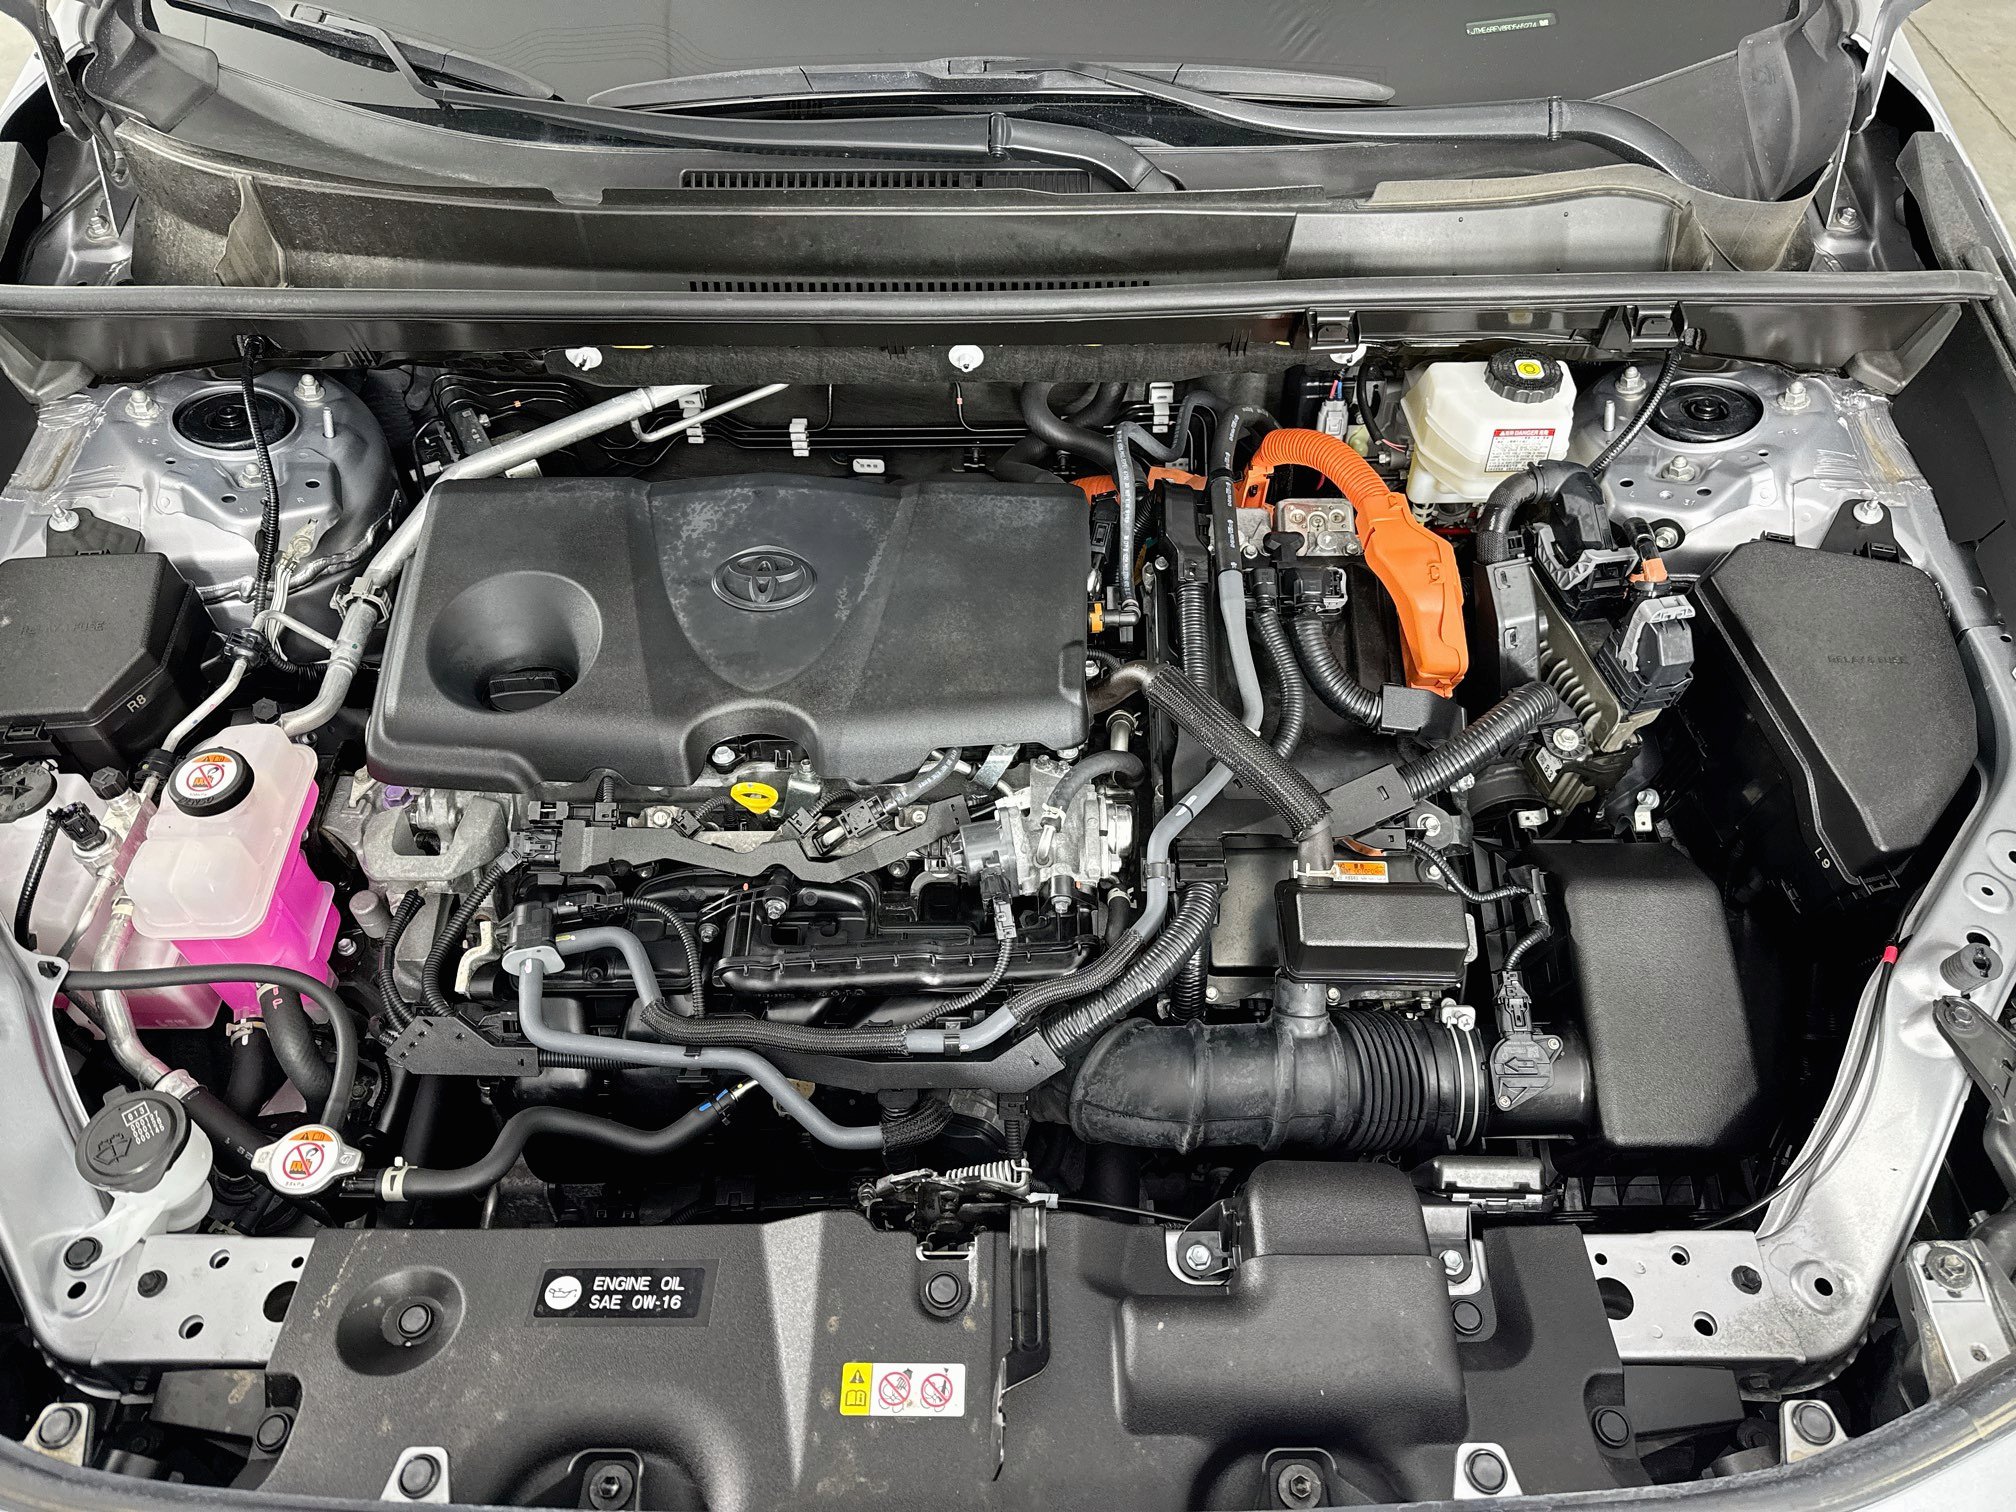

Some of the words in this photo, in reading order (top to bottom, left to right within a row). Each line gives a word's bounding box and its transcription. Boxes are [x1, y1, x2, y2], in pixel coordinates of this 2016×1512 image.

[126, 694, 147, 713] R8
[1814, 846, 1830, 869] L9
[592, 1276, 652, 1291] ENGINE
[660, 1276, 685, 1291] OIL
[588, 1294, 623, 1310] SAE
[631, 1294, 682, 1310] 0W-16
